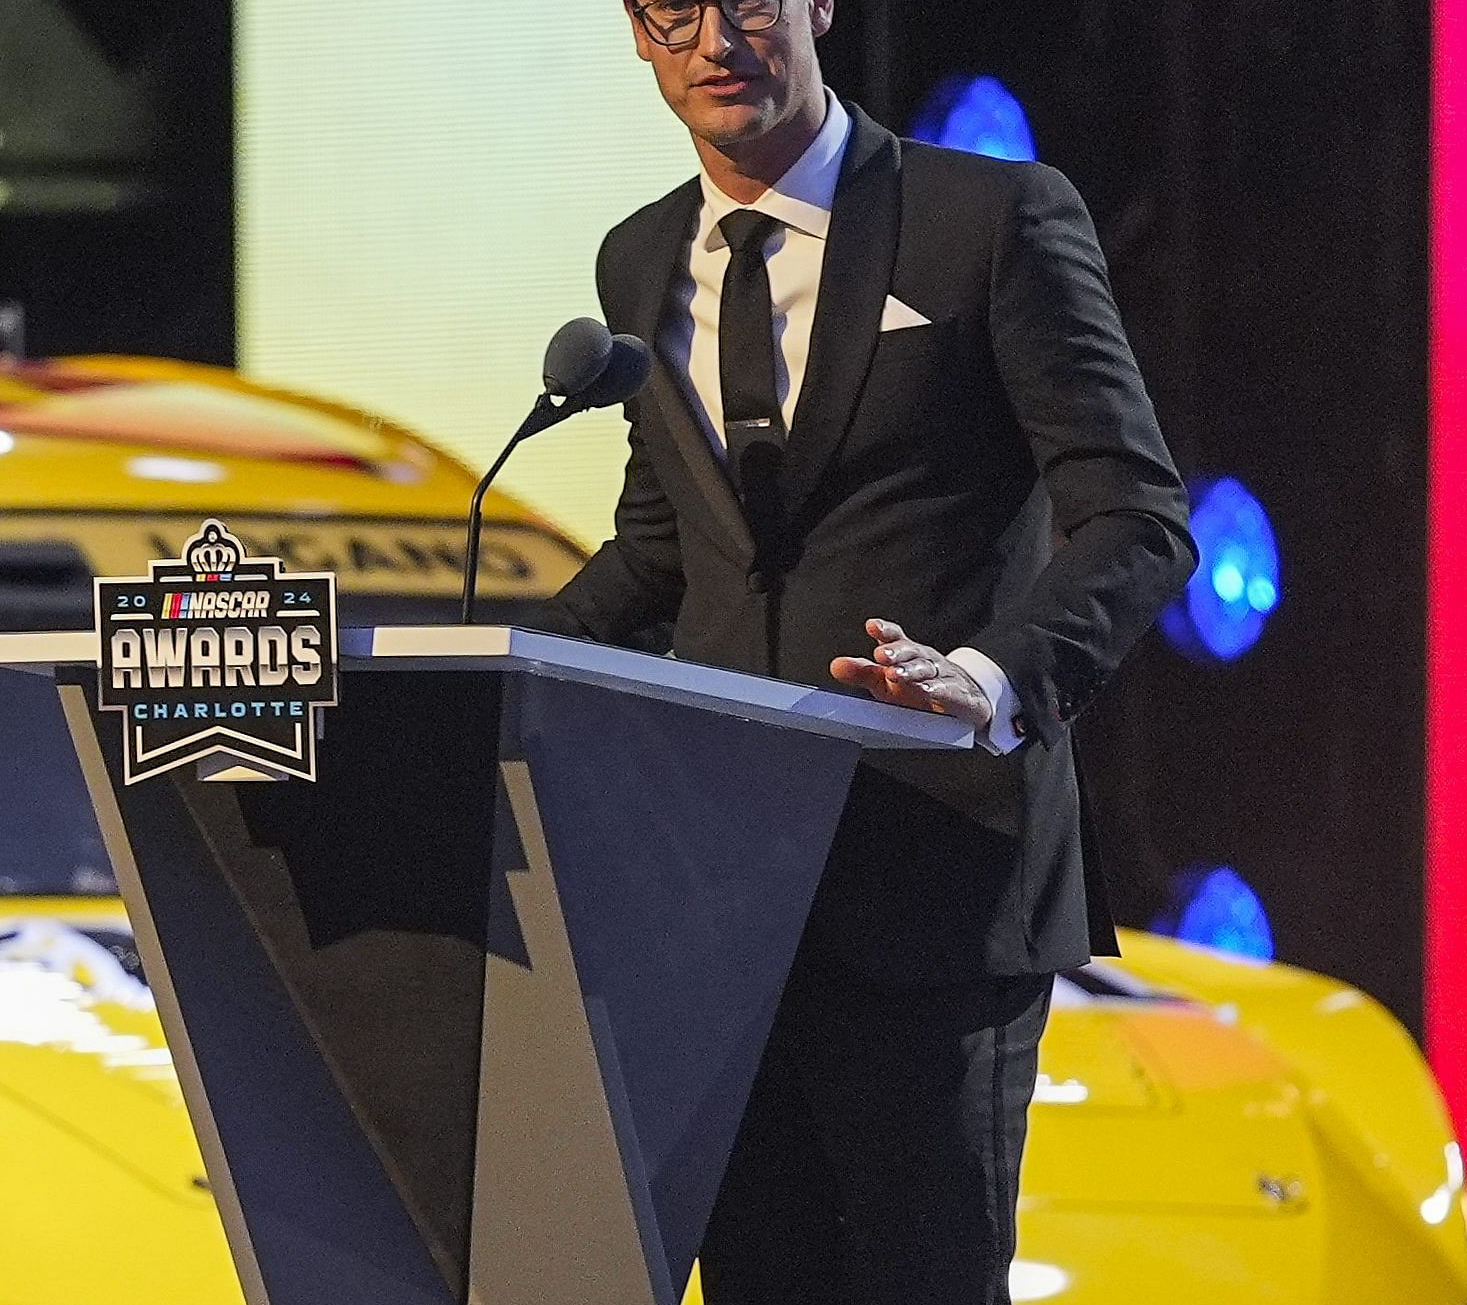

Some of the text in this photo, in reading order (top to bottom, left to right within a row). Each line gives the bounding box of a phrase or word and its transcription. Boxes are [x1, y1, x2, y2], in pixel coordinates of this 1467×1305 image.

[117, 590, 313, 619] 20 NASCAR 24
[111, 625, 322, 689] AWARDS
[133, 700, 304, 720] CHARLOTTE
